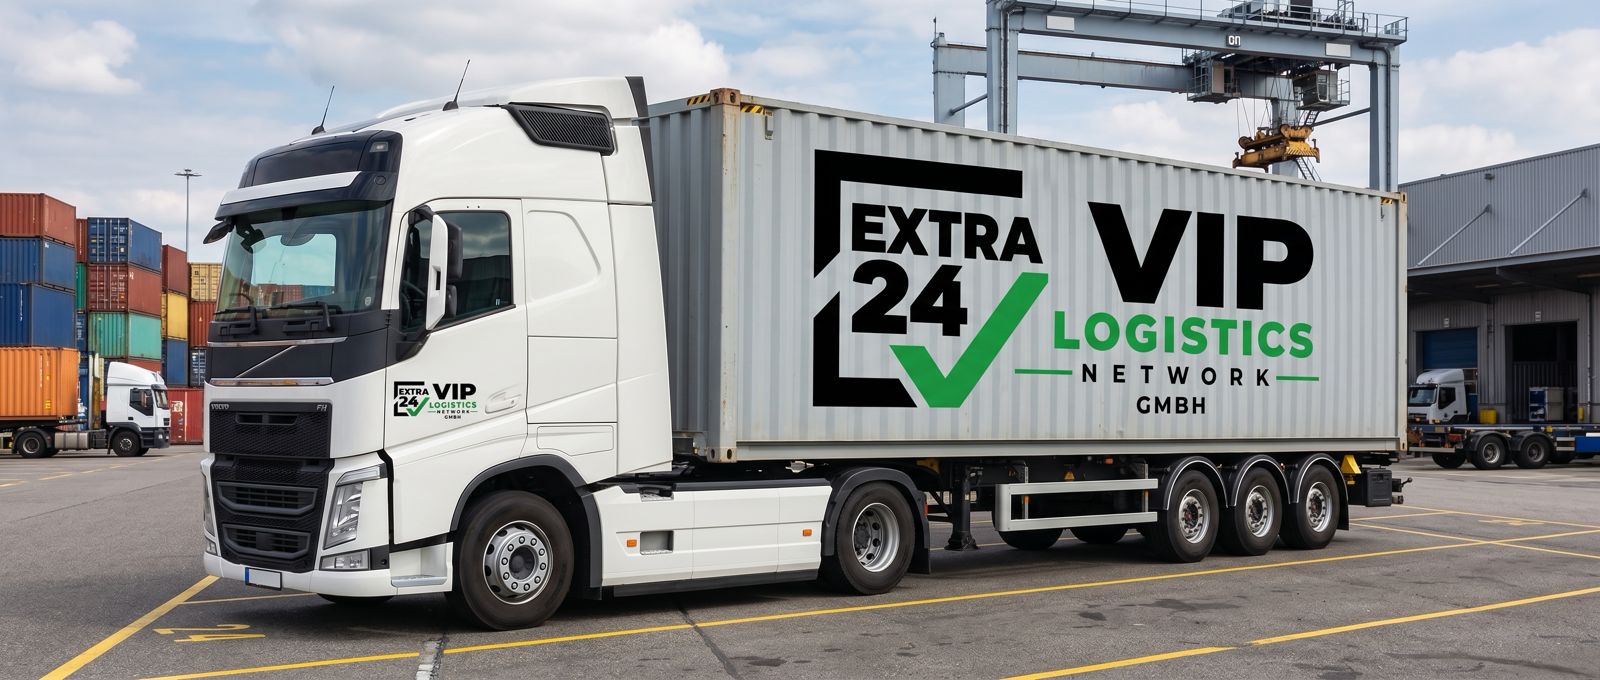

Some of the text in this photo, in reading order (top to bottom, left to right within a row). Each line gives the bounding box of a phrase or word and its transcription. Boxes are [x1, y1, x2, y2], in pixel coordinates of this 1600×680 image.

[851, 203, 1043, 264] EXTRA
[1088, 201, 1314, 311] VIP
[851, 259, 968, 337] 24
[1053, 310, 1314, 359] LOGISTICS
[1082, 363, 1270, 387] NETWORK
[399, 388, 429, 396] EXTRA
[399, 396, 418, 408] 24
[432, 383, 477, 400] VIP
[1136, 396, 1206, 415] GMBH
